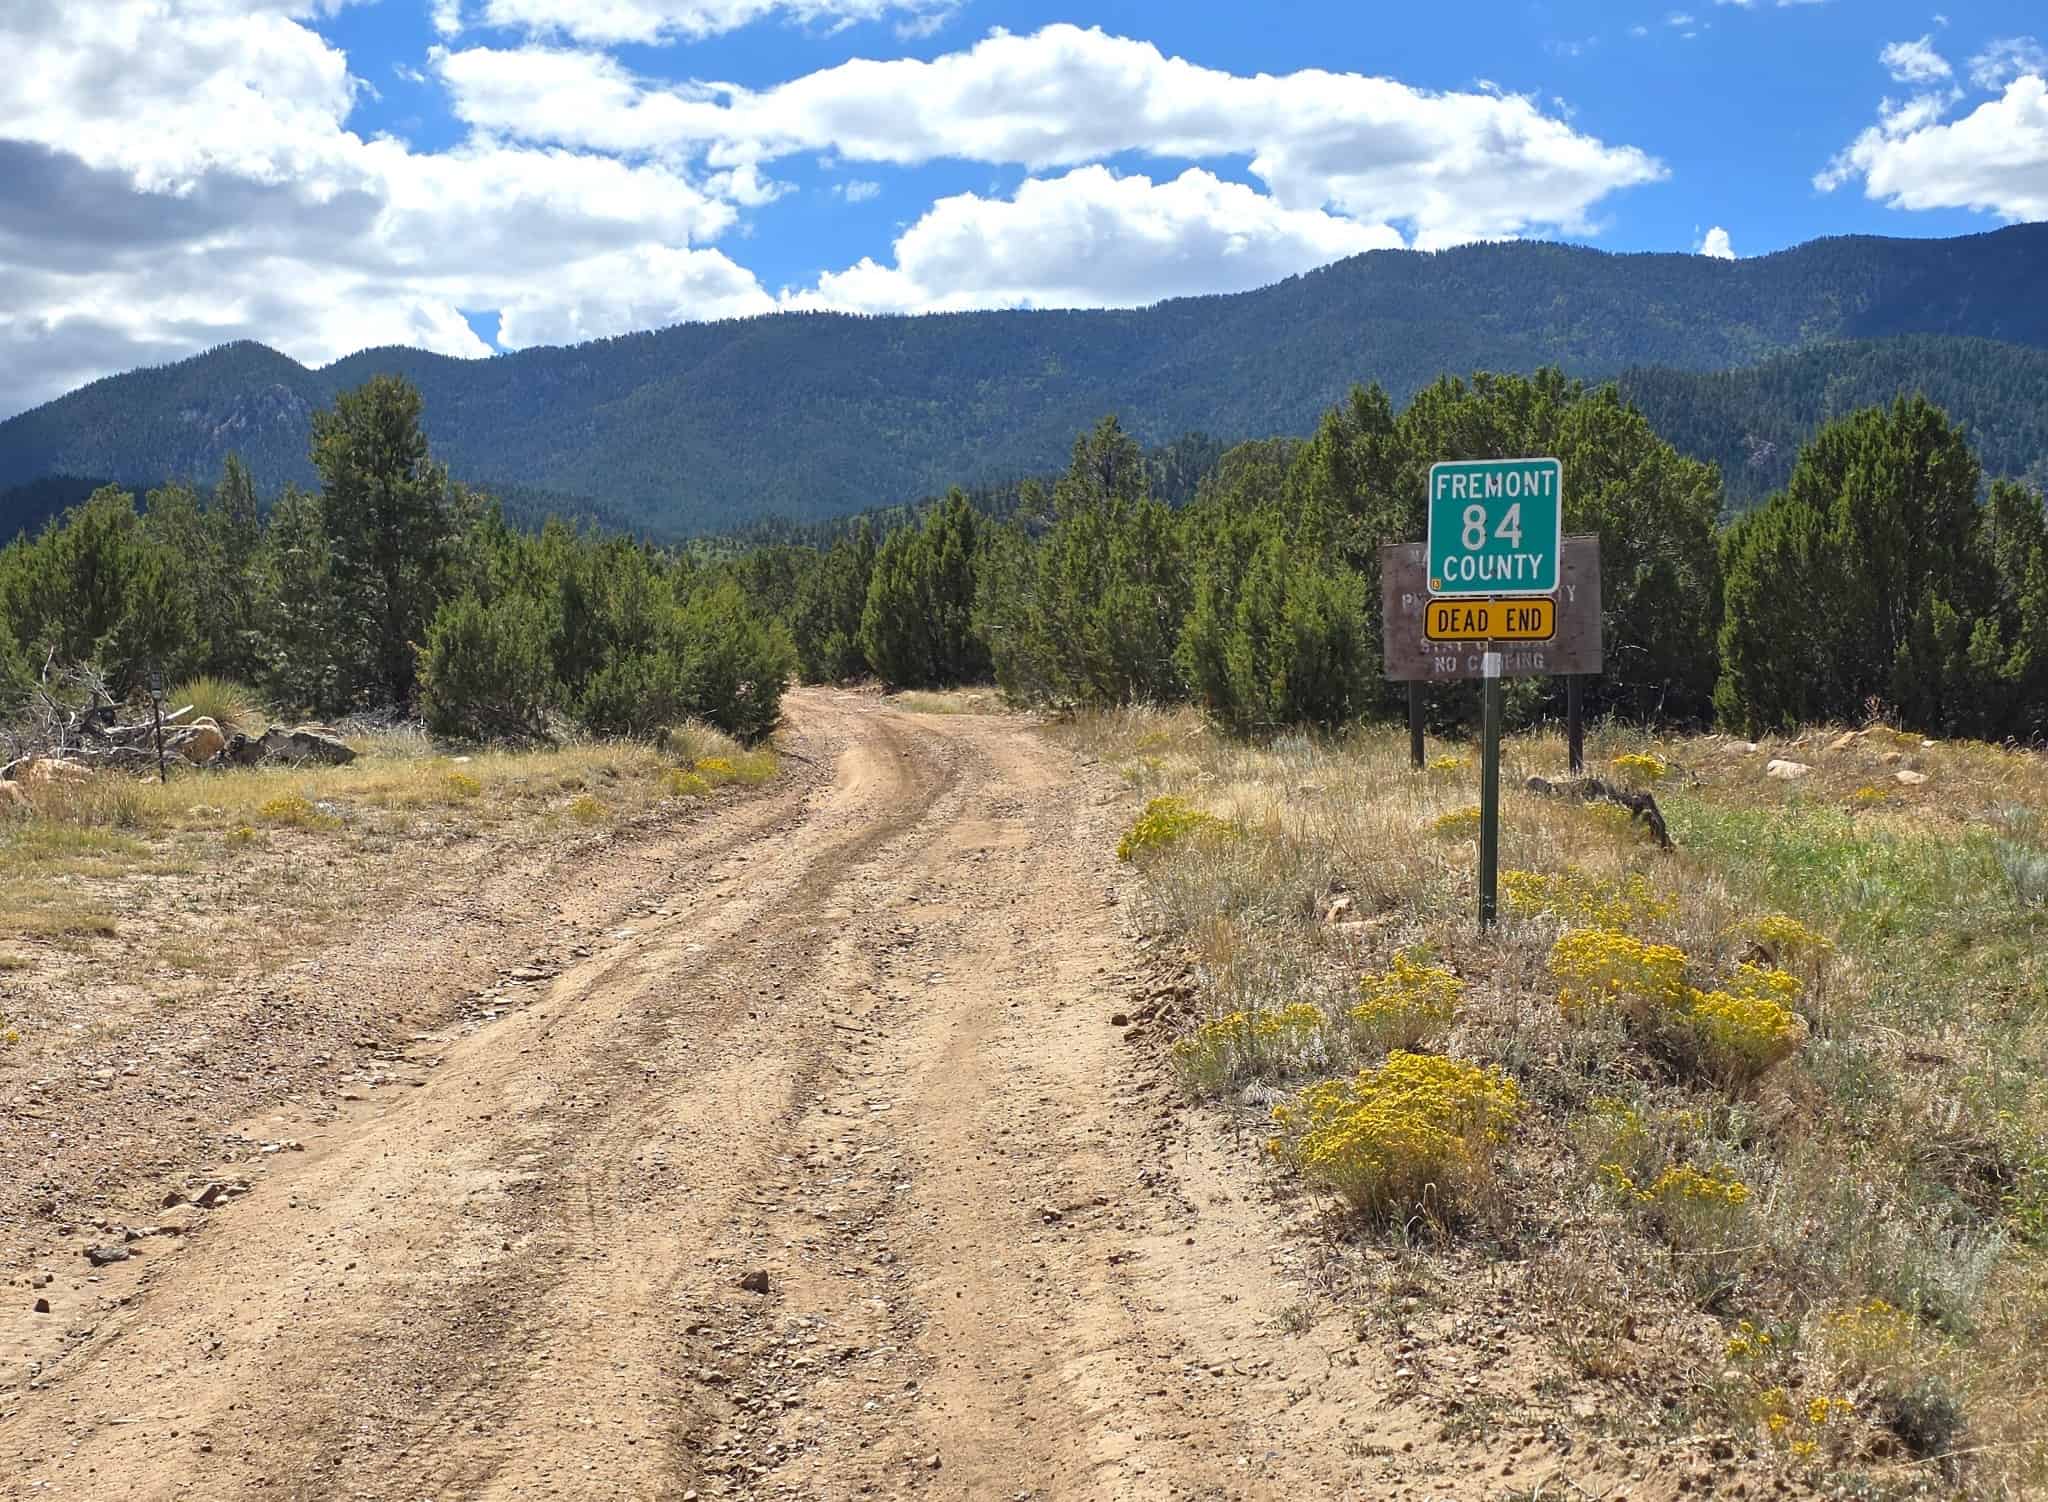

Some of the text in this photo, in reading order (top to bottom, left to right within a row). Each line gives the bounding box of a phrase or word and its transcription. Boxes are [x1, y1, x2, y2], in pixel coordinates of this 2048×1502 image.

[1436, 470, 1555, 500] FREMONT
[1461, 503, 1522, 551] 84
[1443, 553, 1543, 581] COUNTY
[1438, 607, 1542, 633] DEAD END
[1434, 652, 1545, 673] NO CPING
